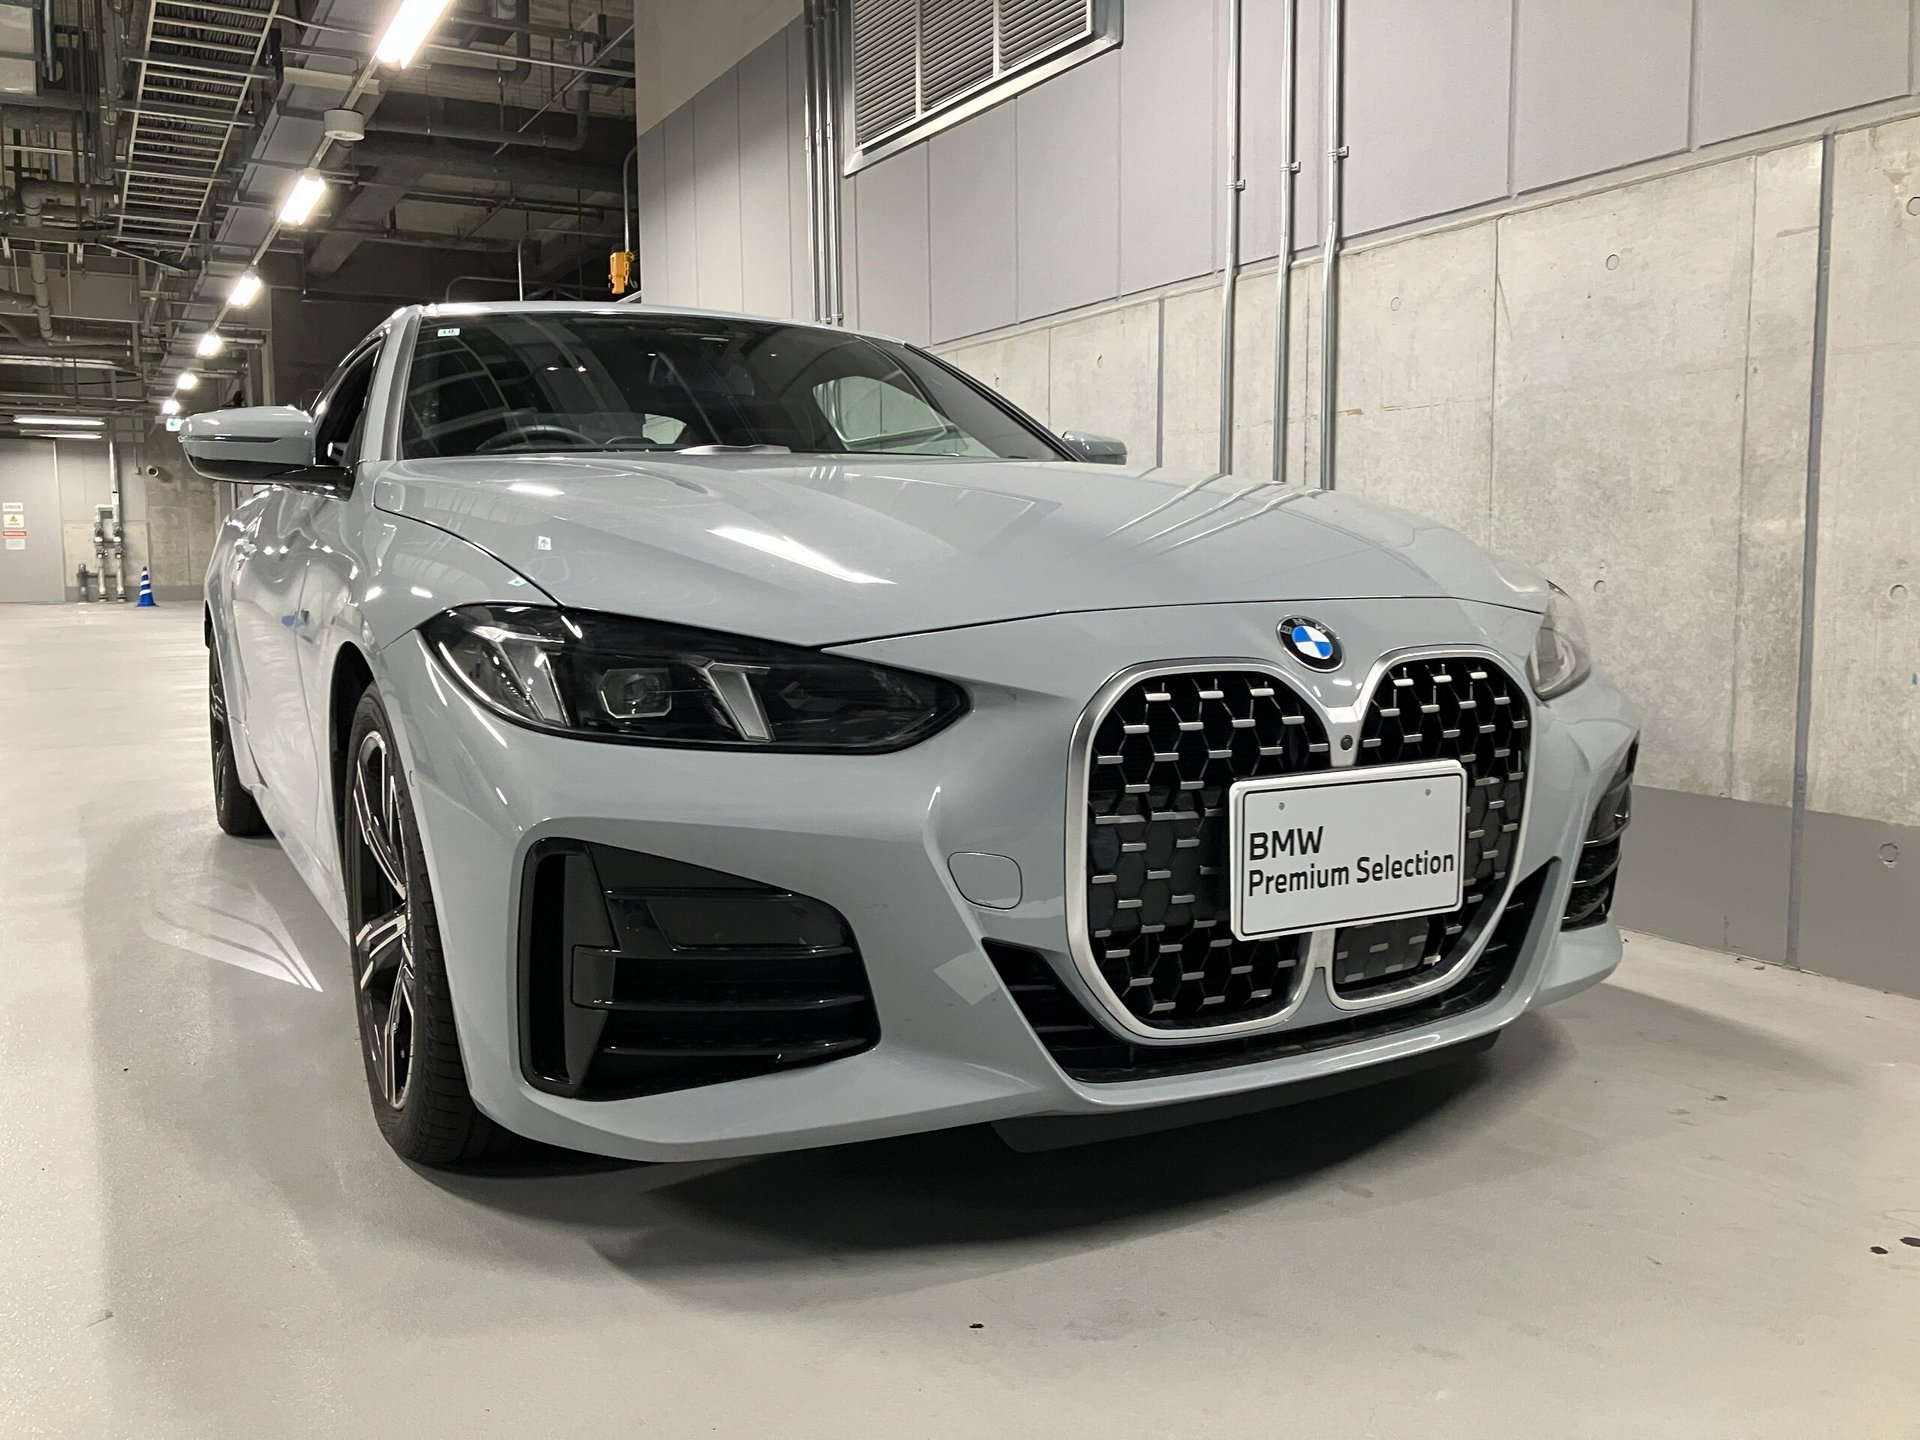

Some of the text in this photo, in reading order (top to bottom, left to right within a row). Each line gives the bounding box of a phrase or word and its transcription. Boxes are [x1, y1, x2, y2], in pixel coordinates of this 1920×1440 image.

[1280, 618, 1327, 635] BMW
[1249, 825, 1324, 861] BMW
[1249, 850, 1454, 896] Premium Selection
